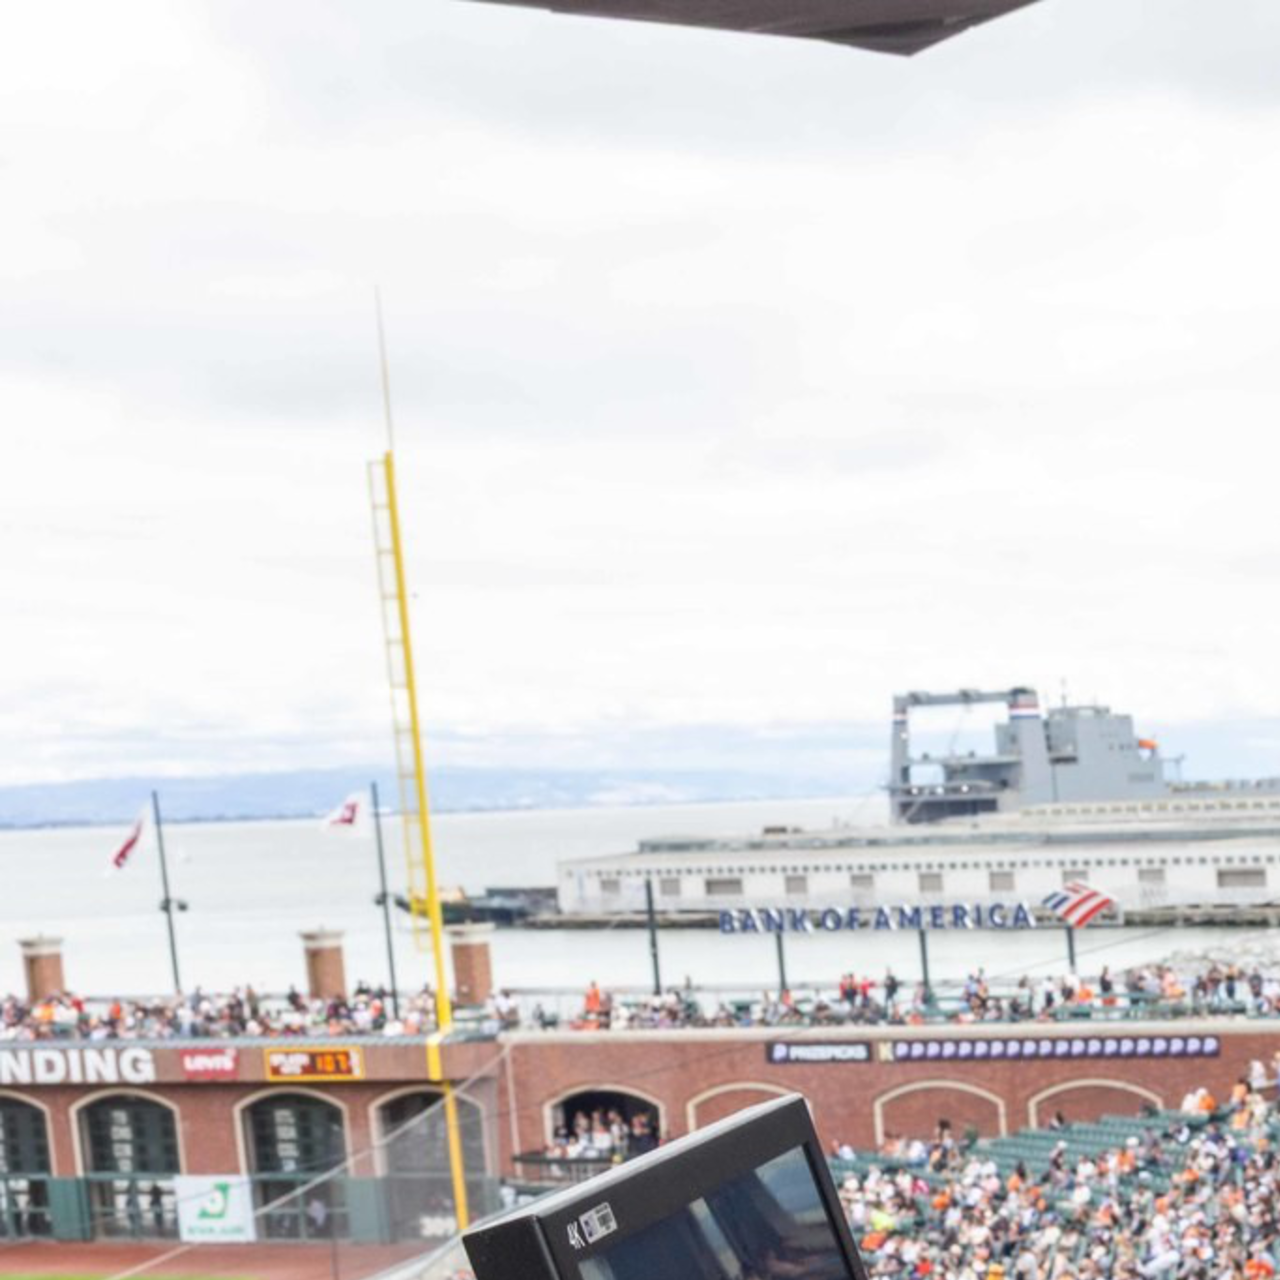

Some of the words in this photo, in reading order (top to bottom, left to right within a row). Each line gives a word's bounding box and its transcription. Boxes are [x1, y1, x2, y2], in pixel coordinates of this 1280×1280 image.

[718, 908, 812, 935] BANK
[821, 906, 862, 932] OF
[874, 902, 1036, 930] AMERICA
[0, 1048, 156, 1083] NDING
[566, 1221, 587, 1250] 4K
